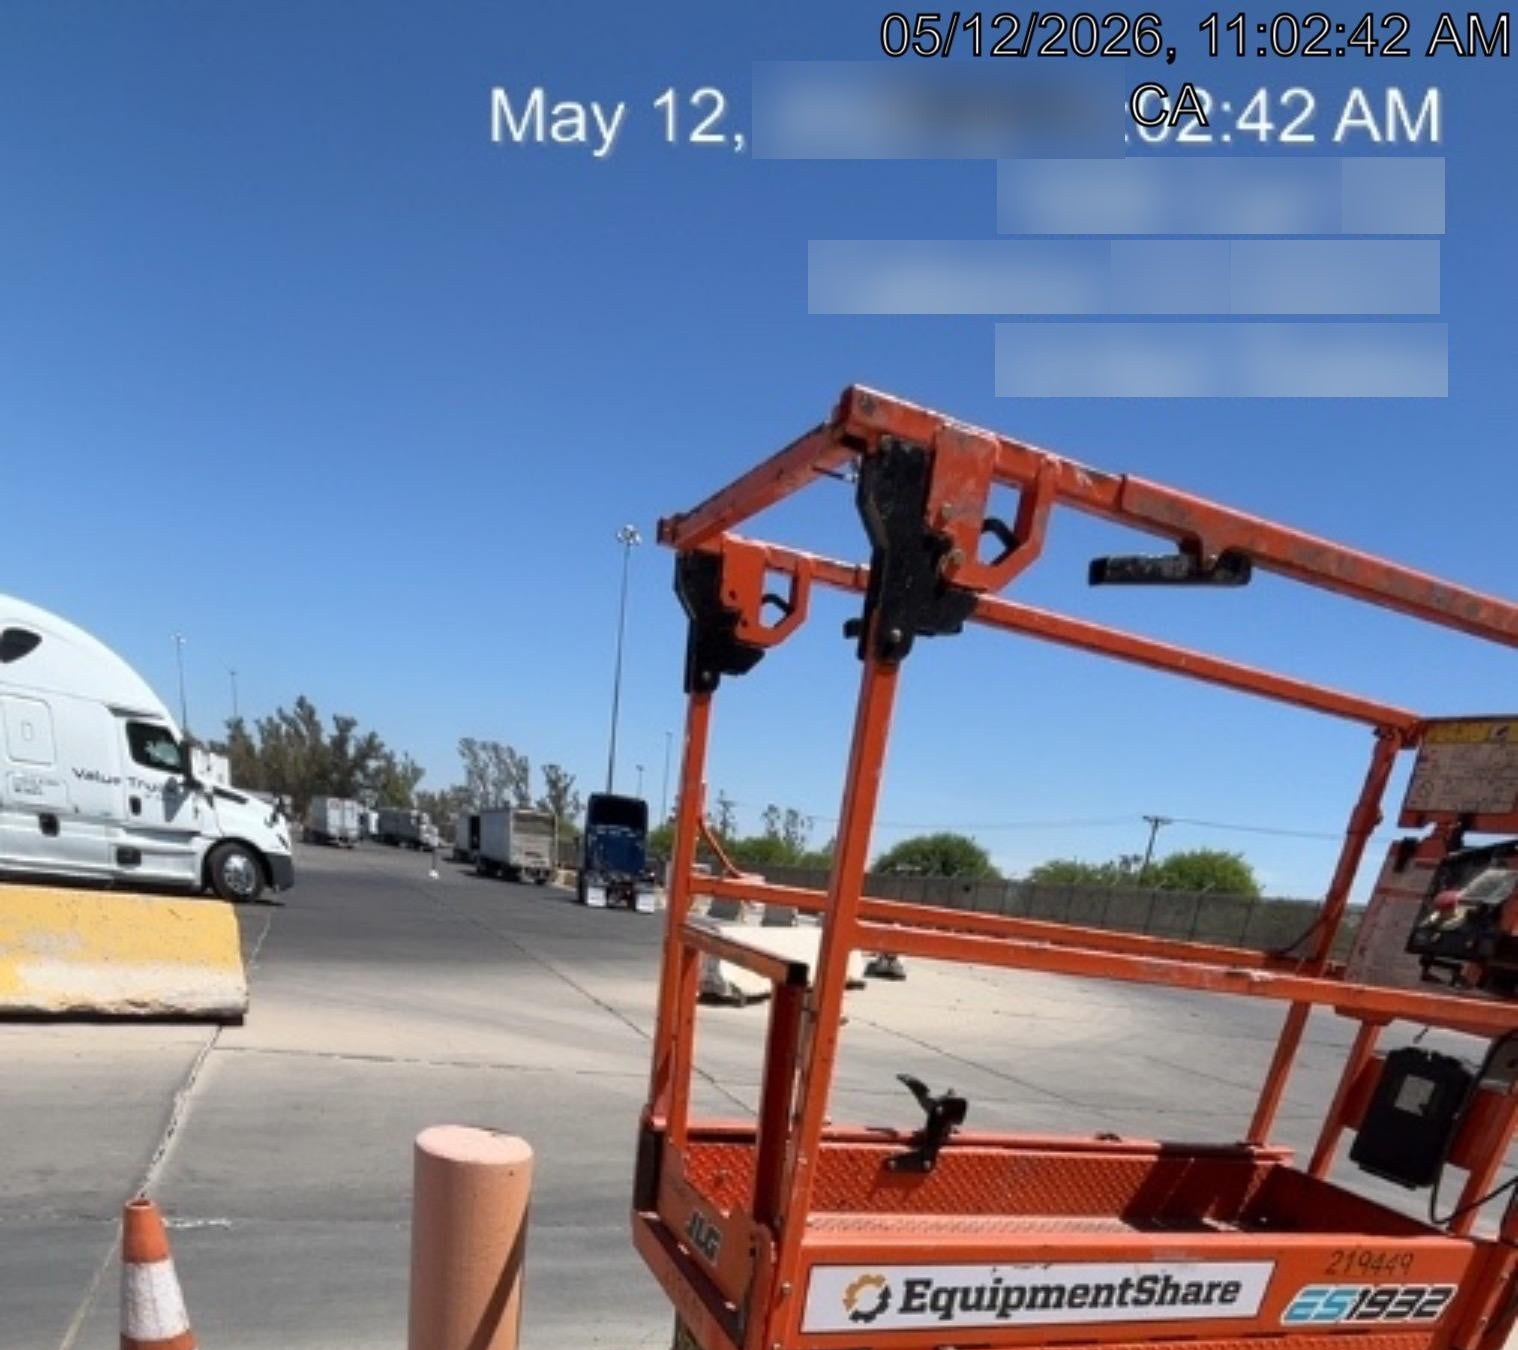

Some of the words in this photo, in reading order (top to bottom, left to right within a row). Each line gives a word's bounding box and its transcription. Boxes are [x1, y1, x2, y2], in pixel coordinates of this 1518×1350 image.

[72, 767, 121, 785] Value
[1326, 1249, 1414, 1277] 219449
[898, 1274, 1242, 1320] EquipmentShare
[1282, 1285, 1458, 1323] ES1932
